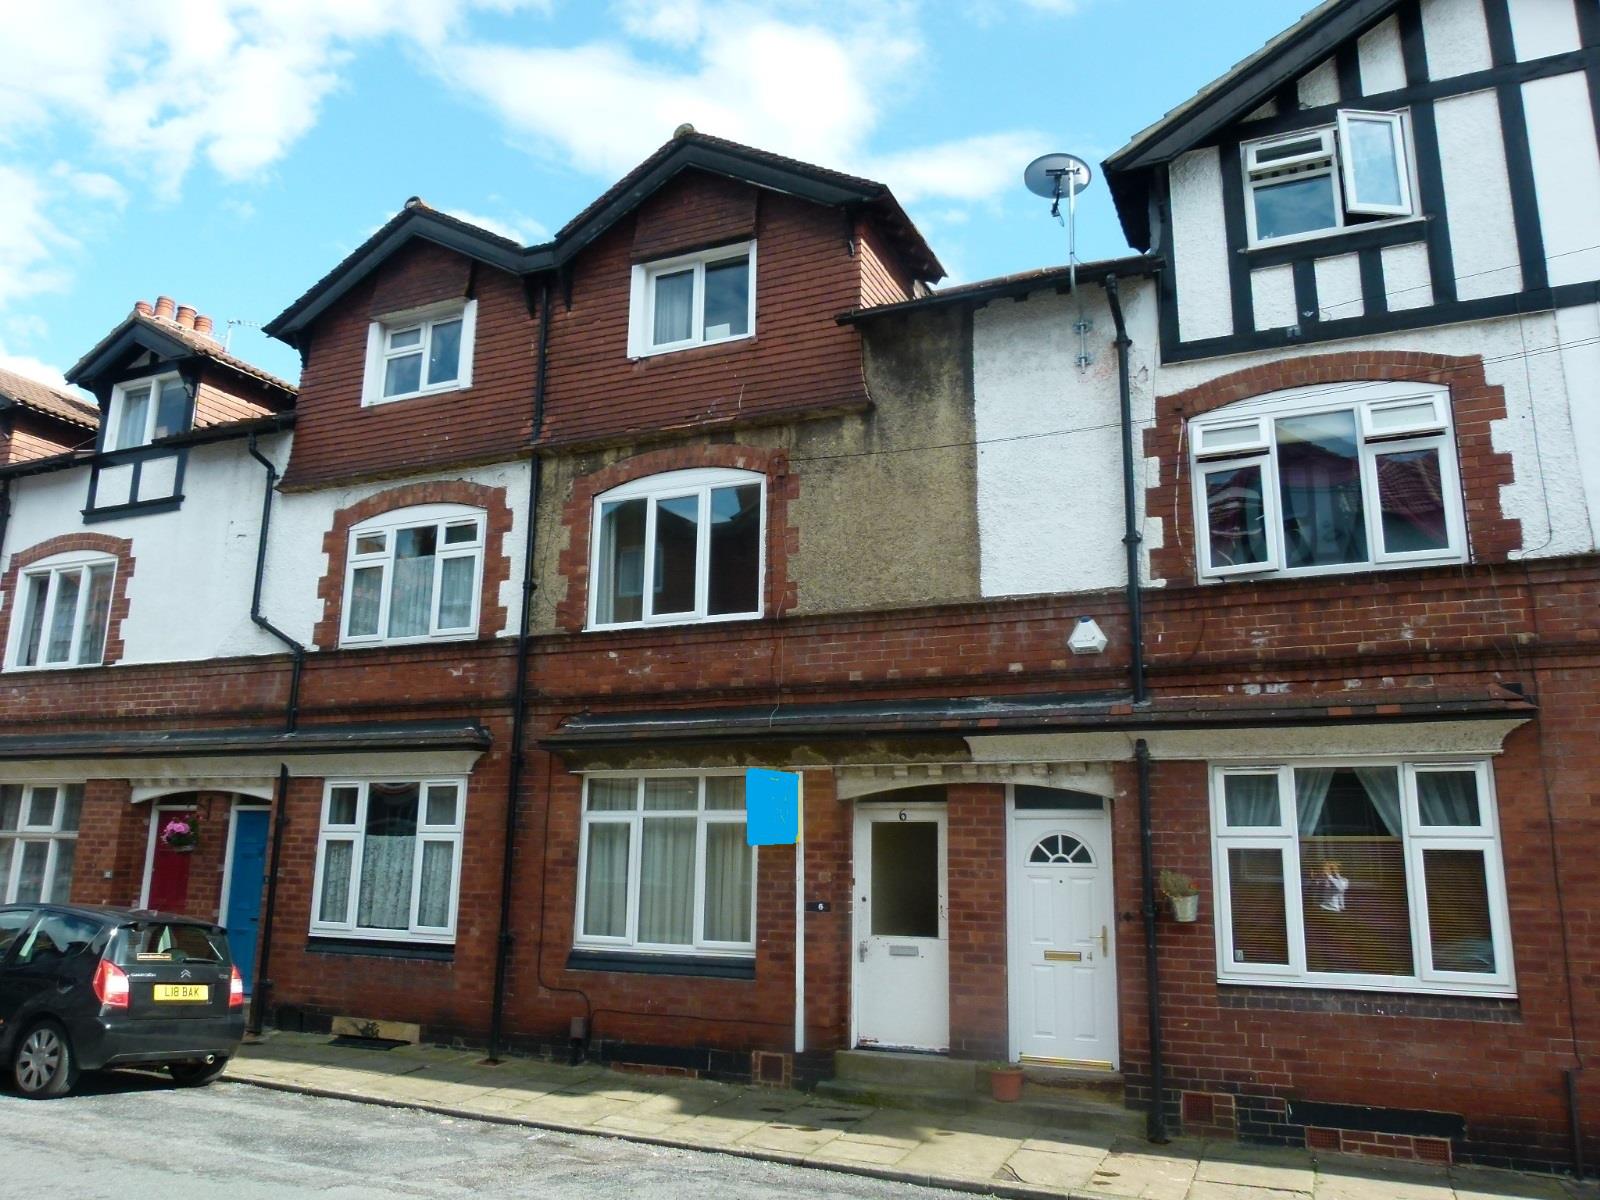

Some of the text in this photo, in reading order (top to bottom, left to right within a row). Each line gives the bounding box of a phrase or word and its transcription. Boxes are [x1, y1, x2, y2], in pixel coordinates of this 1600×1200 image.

[899, 808, 907, 821] 6
[818, 903, 824, 911] 6
[1086, 952, 1093, 961] 4
[182, 986, 199, 997] BAK
